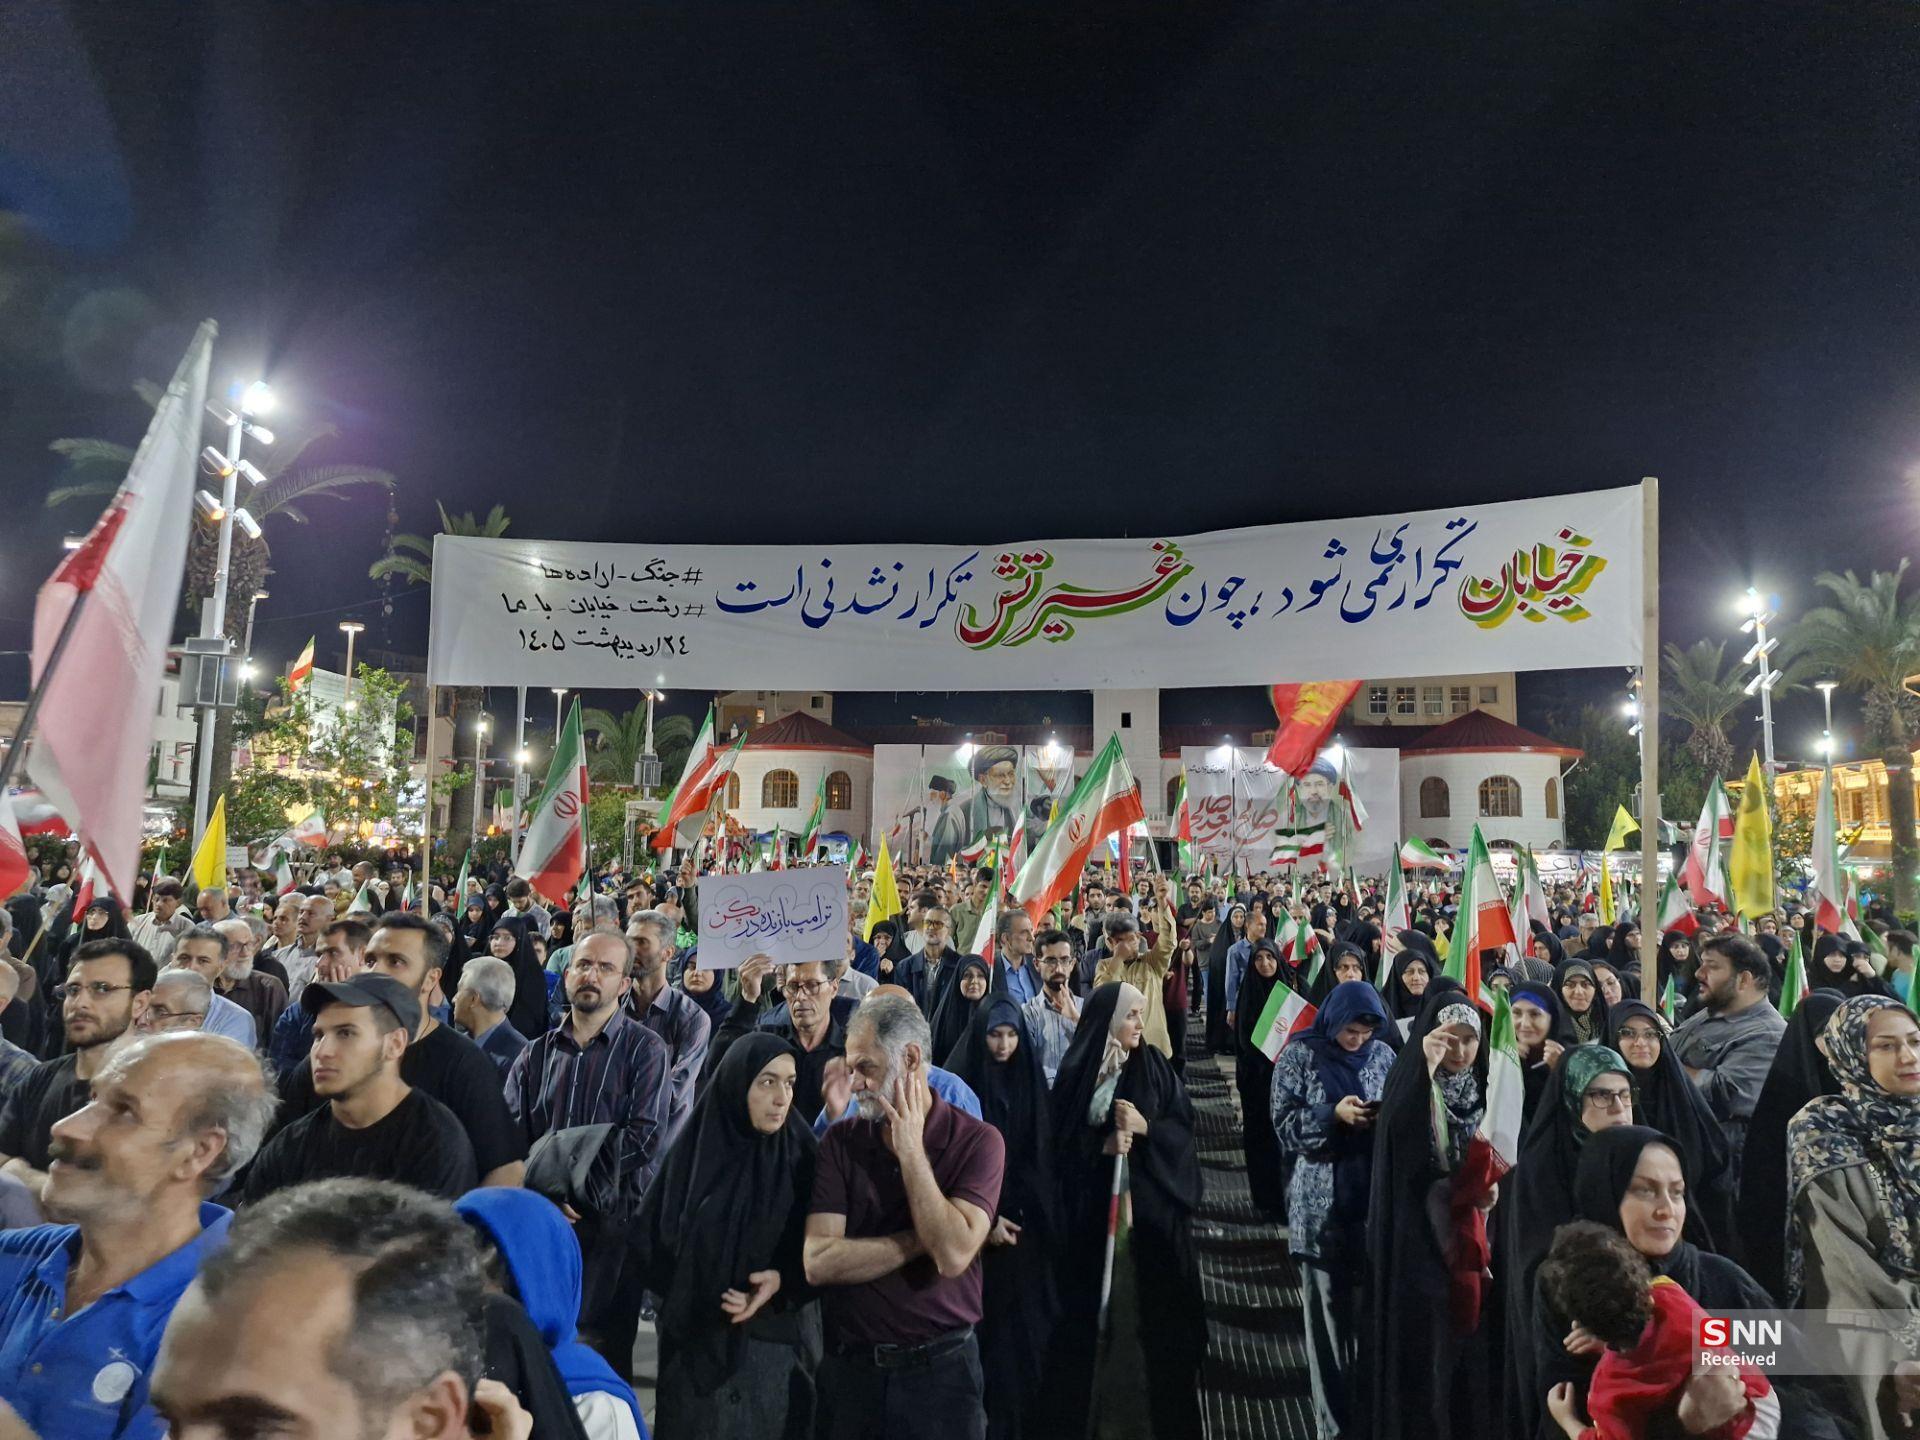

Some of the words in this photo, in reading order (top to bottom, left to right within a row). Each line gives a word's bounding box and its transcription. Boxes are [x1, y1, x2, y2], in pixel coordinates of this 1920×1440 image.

[715, 564, 803, 613] است
[896, 551, 980, 628] تکرار
[1457, 526, 1607, 629] خیابان
[1165, 576, 1247, 630] چون
[731, 917, 760, 938] در
[760, 897, 790, 937] بازنده
[791, 894, 832, 934] ترامپ
